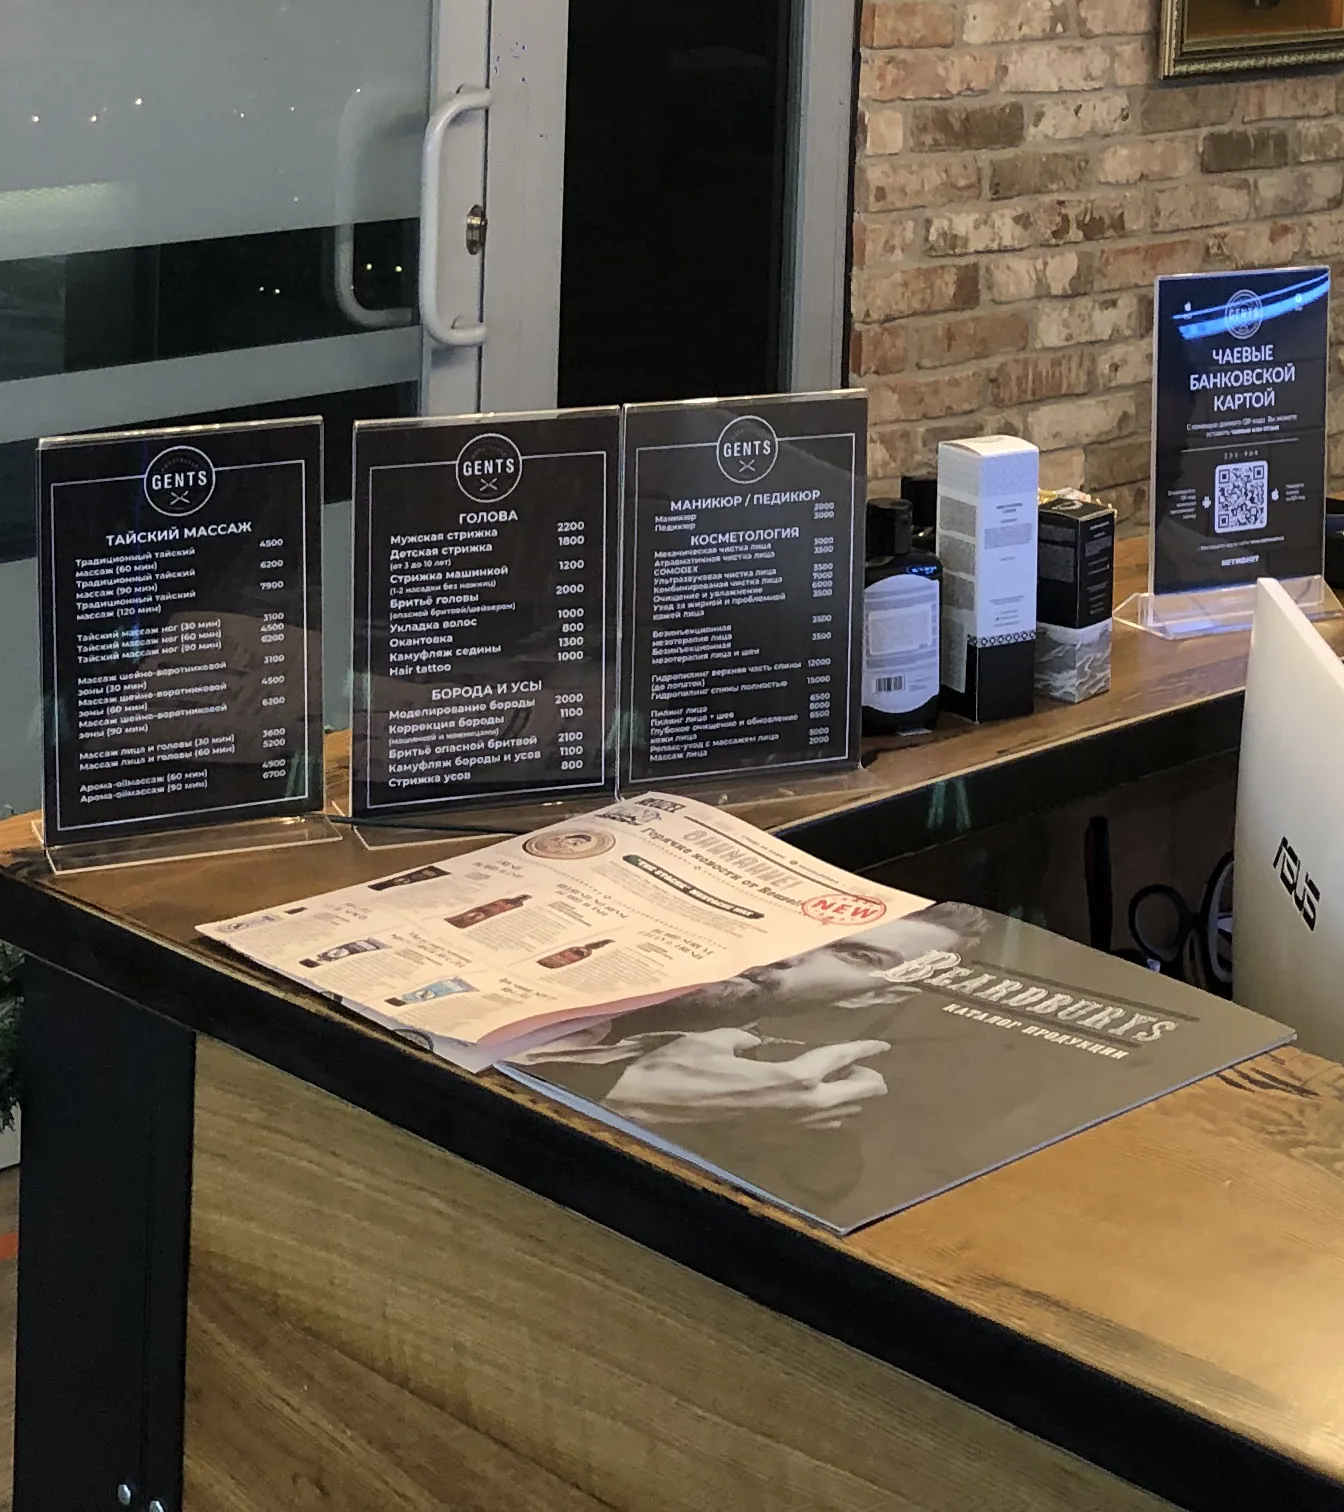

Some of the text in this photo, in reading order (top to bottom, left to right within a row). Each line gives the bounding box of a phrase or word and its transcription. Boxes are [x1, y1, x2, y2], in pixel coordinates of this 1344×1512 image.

[1212, 344, 1274, 365] ЧАЕВЫЕ
[1189, 363, 1296, 391] БАНКОВСКОЙ
[1213, 388, 1275, 412] КАРТОЙ
[723, 440, 771, 458] GENTS
[462, 458, 515, 477] GENTS
[152, 470, 207, 490] GENTS
[670, 489, 821, 512] МАНИКЮР / ПЕДИКЮР
[459, 509, 519, 525] ГОЛОВА
[105, 521, 252, 547] ТАЙСКИЙ МАССАЖ
[557, 520, 585, 532] 2200
[259, 538, 284, 548] 4500
[390, 528, 498, 546] Мужская стрижка
[558, 535, 585, 547] 1800
[690, 526, 800, 546] КОСМЕТОЛОГИЯ
[389, 543, 493, 561] Детская стрижка
[559, 559, 585, 570] 1200
[389, 565, 509, 585] Стрижка машинкой
[259, 580, 284, 591] 7900
[555, 583, 585, 595] 2000
[435, 593, 479, 605] головы
[263, 612, 285, 622] 3100
[557, 607, 585, 619] 1000
[389, 618, 477, 634] Укладка волос
[562, 622, 584, 633] 800
[389, 634, 453, 648] Окантовка
[558, 636, 584, 648] 1300
[263, 654, 285, 664] 3100
[389, 644, 502, 662] Камуфляж седины
[557, 650, 584, 662] 1000
[389, 663, 452, 677] Hair tattoo
[431, 679, 542, 701] БОРОДА И УСЫ
[554, 692, 584, 705] 2000
[261, 696, 286, 707] 6200
[388, 698, 536, 720] Моделирование бороды
[560, 707, 584, 718] 1100
[388, 715, 505, 735] Коррекция бороды
[262, 738, 286, 748] 5200
[434, 740, 485, 754] опасной
[487, 735, 538, 750] бритвой
[558, 731, 584, 743] 2100
[559, 745, 584, 756] 1100
[388, 750, 541, 773] Камуфляж бороды и усов
[561, 759, 584, 770] 800
[388, 771, 471, 788] Стрижка усов
[641, 827, 692, 854] Горячие
[691, 852, 742, 881] новости
[741, 879, 759, 888] от
[683, 829, 804, 890] ВНИМАНИЕ!
[1273, 836, 1320, 931] ASUS
[811, 898, 879, 919] NEW
[870, 949, 1179, 1042] BEARDBURYS
[942, 1003, 1129, 1060] КАТАЛОГ ПРОДУКЦИИ
